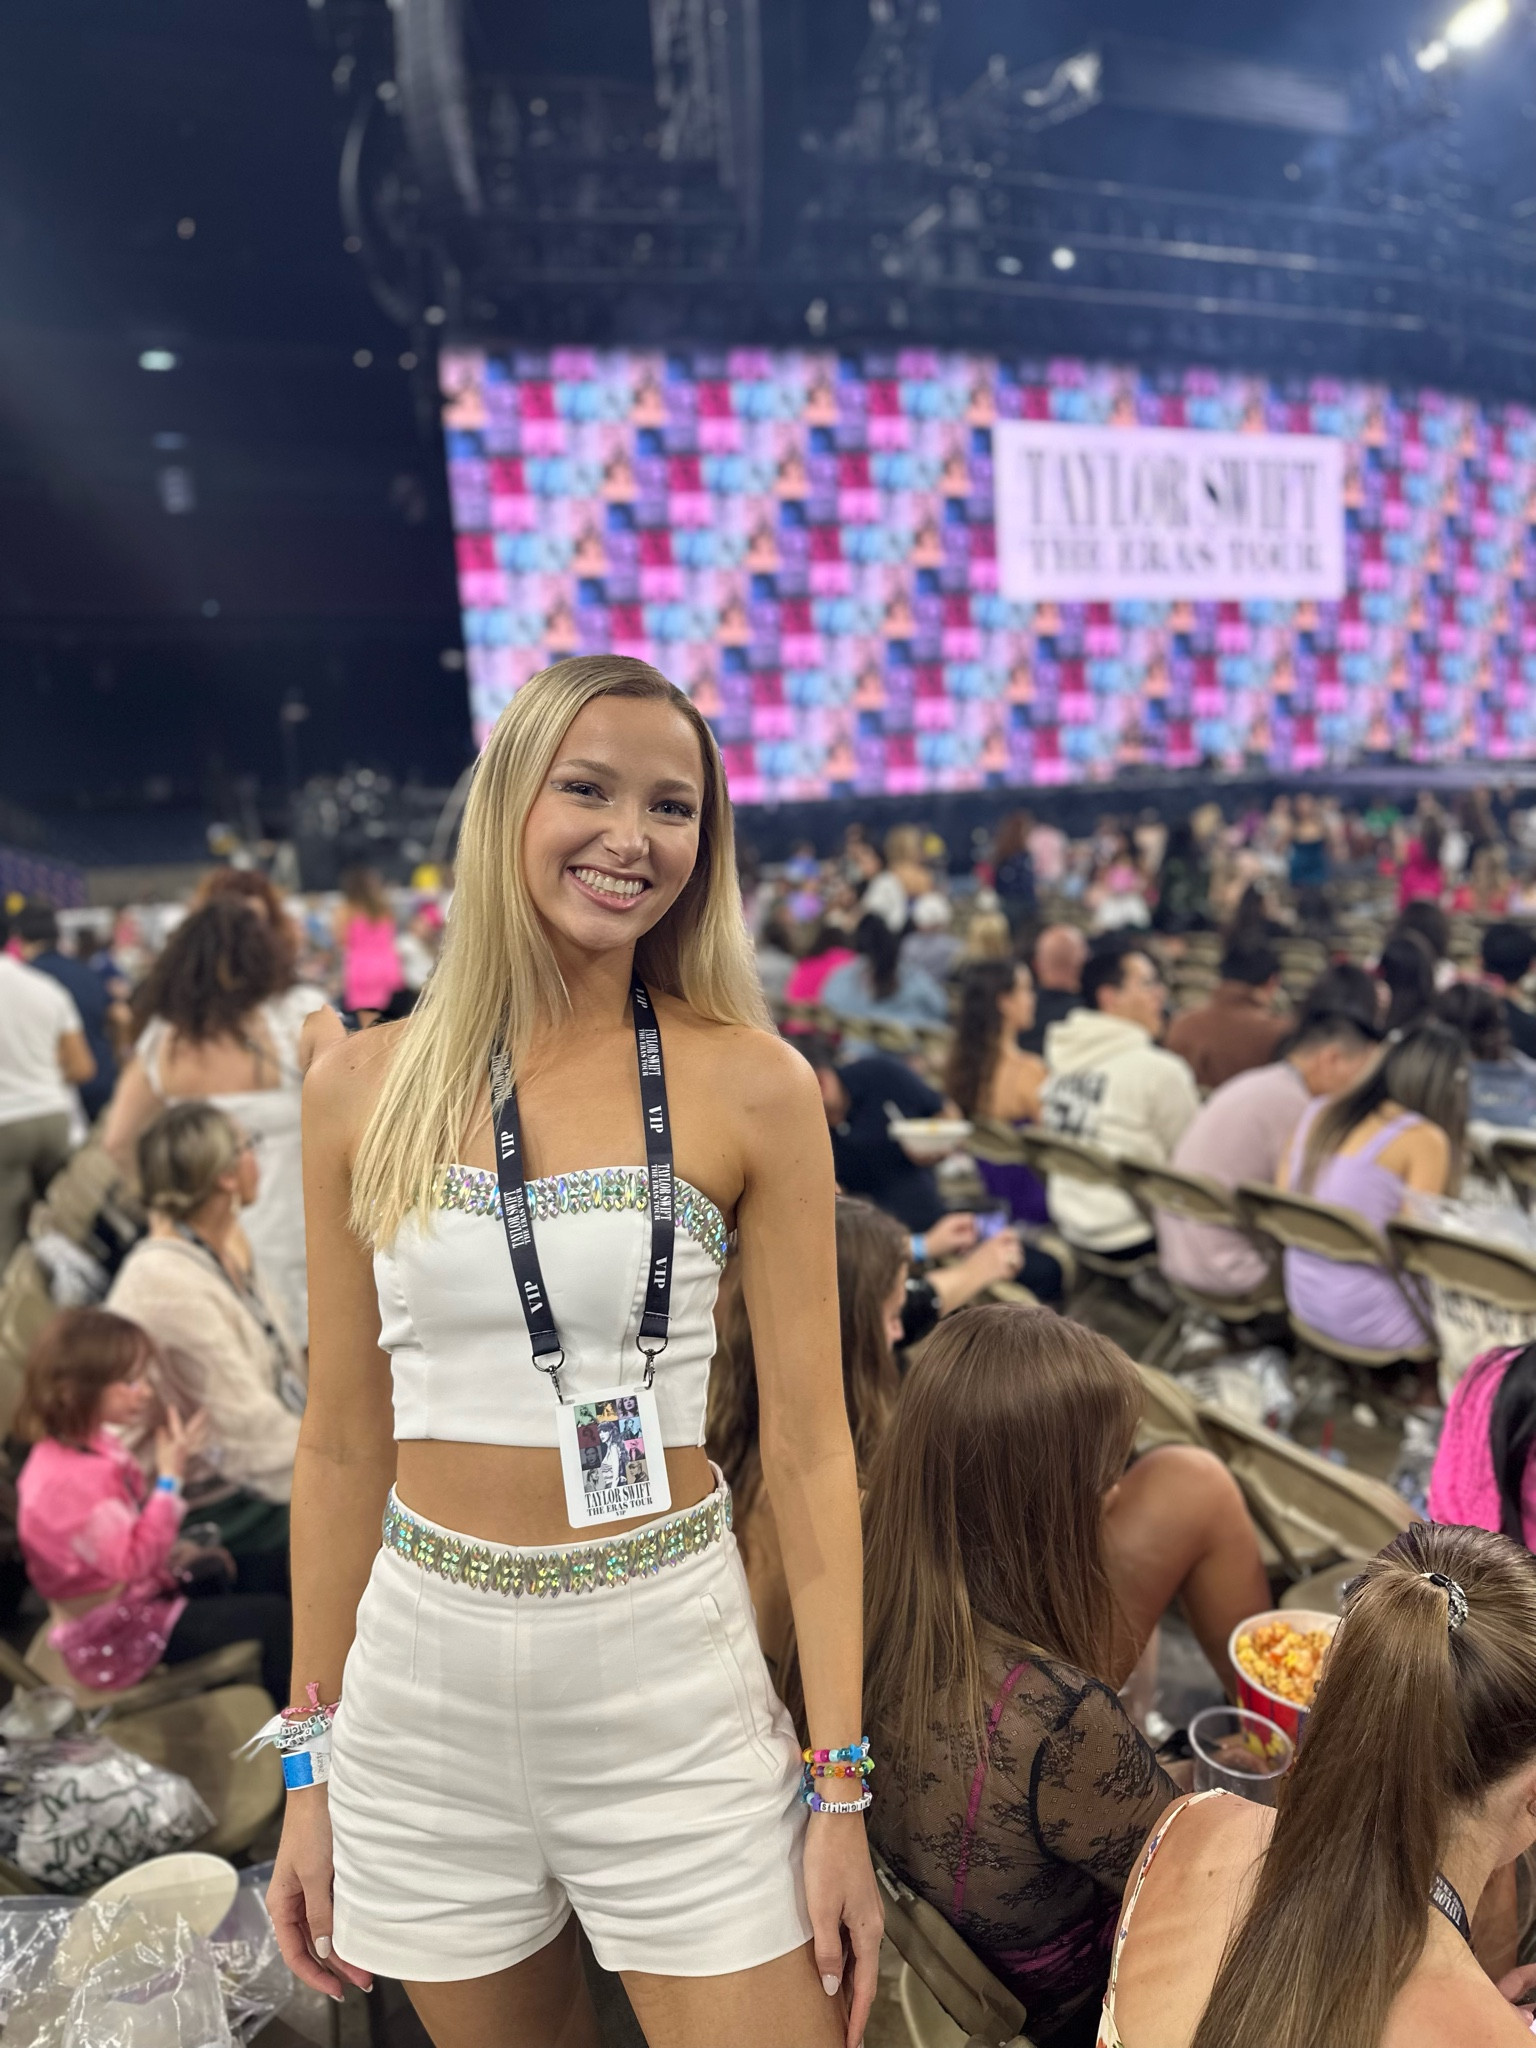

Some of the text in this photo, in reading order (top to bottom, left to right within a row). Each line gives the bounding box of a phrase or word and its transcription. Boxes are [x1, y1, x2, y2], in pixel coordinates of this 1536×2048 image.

[1023, 447, 1318, 530] TAYLOR SWIFT
[1026, 537, 1323, 576] THE ERAS TOUR
[638, 1028, 646, 1040] THE
[645, 1028, 661, 1076] TAYLOR SWIFT
[648, 1105, 664, 1134] VIP
[501, 1131, 516, 1160] VIP
[650, 1163, 661, 1221] THE ERAS TOUR
[657, 1163, 672, 1221] TAYLOR SWIFT
[503, 1190, 525, 1249] TAYLOR SWIFT
[515, 1187, 531, 1245] THE ERAS TOUR
[654, 1256, 668, 1289] VIP
[524, 1280, 543, 1314] VIP
[585, 1482, 651, 1508] TAYLOR SWIFT
[587, 1497, 653, 1517] THE ERAS TOUR
